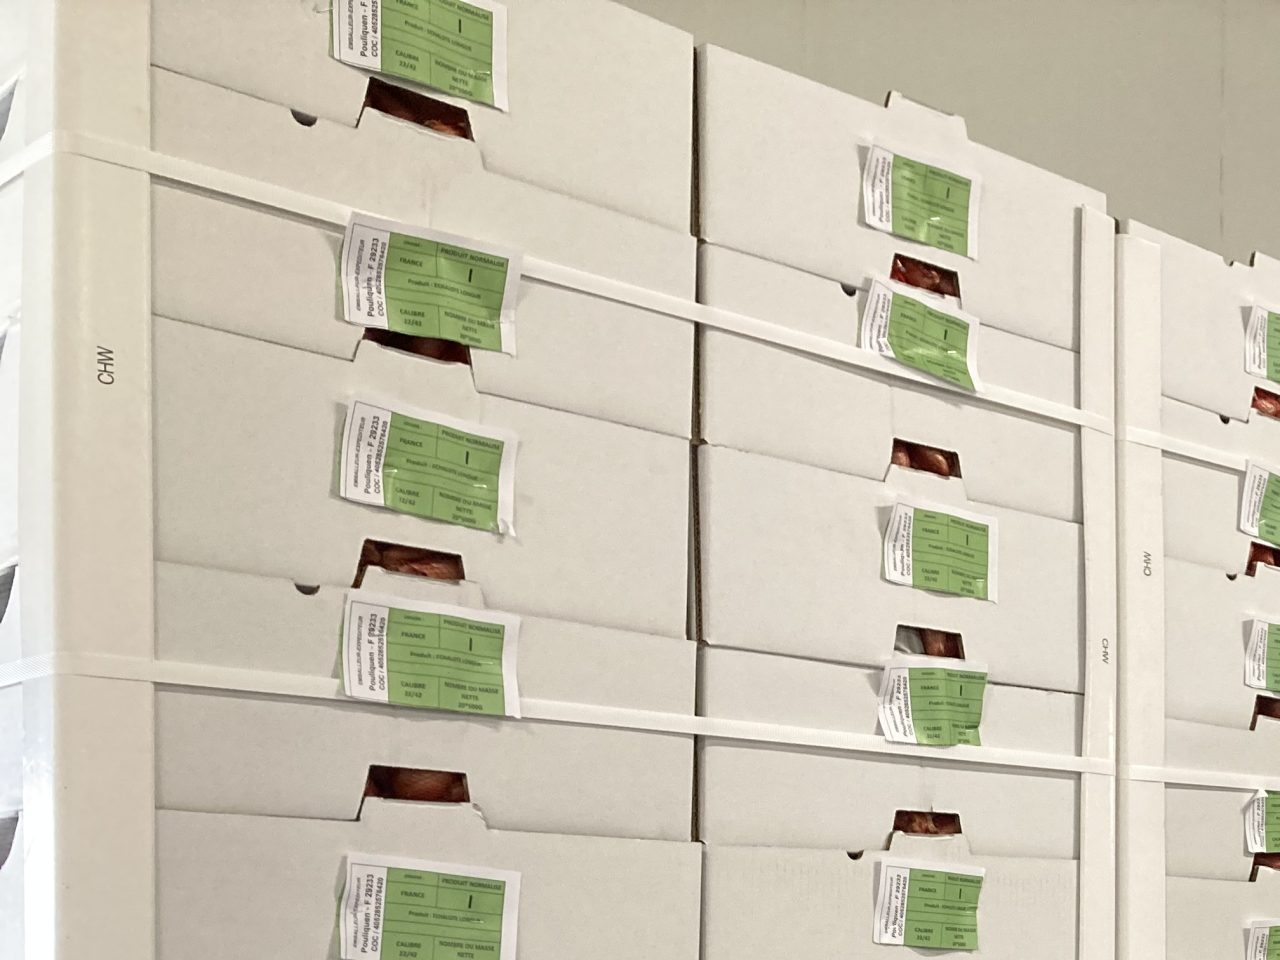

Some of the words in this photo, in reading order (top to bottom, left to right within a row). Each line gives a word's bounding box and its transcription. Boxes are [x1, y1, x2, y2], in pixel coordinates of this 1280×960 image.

[360, 15, 369, 57] Pouliquen
[369, 237, 379, 262] 29233
[399, 257, 423, 268] FRANCE
[377, 300, 385, 316] COC
[97, 345, 115, 385] CHW
[364, 454, 373, 495] Pouliquen
[369, 415, 380, 440] 29233
[399, 437, 423, 448] FRANCE
[1143, 551, 1152, 577] CHW
[401, 631, 426, 640] FRANCE
[368, 652, 377, 691] Pouliquen
[364, 873, 375, 898] 29233
[400, 890, 425, 900] FRANCE
[361, 912, 371, 953] Pouliquen
[371, 936, 379, 952] COC
